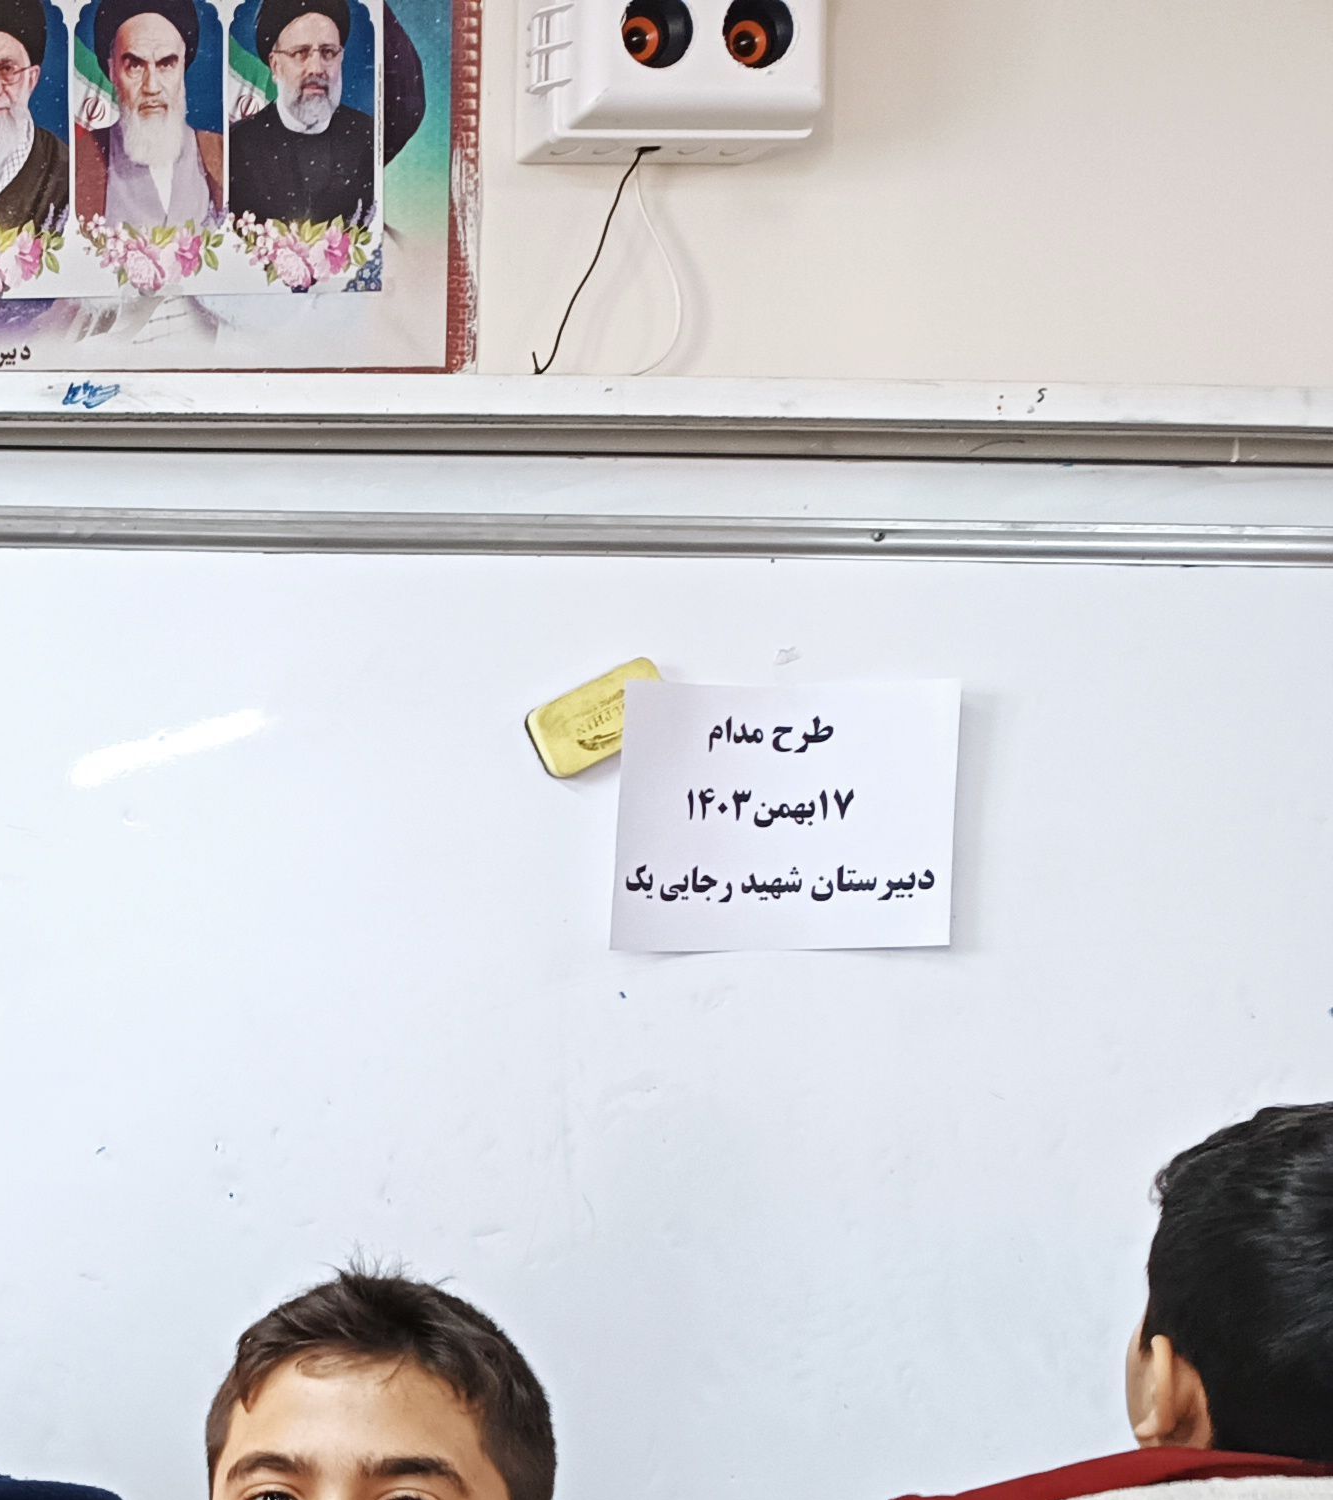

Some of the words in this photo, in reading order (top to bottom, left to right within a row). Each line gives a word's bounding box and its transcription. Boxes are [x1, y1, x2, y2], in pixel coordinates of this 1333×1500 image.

[707, 715, 764, 753] مدام
[771, 715, 835, 754] طرح
[625, 863, 654, 900] یک
[659, 865, 734, 903] رجایی
[740, 866, 804, 900] شهید
[810, 864, 935, 902] دبیرستان
